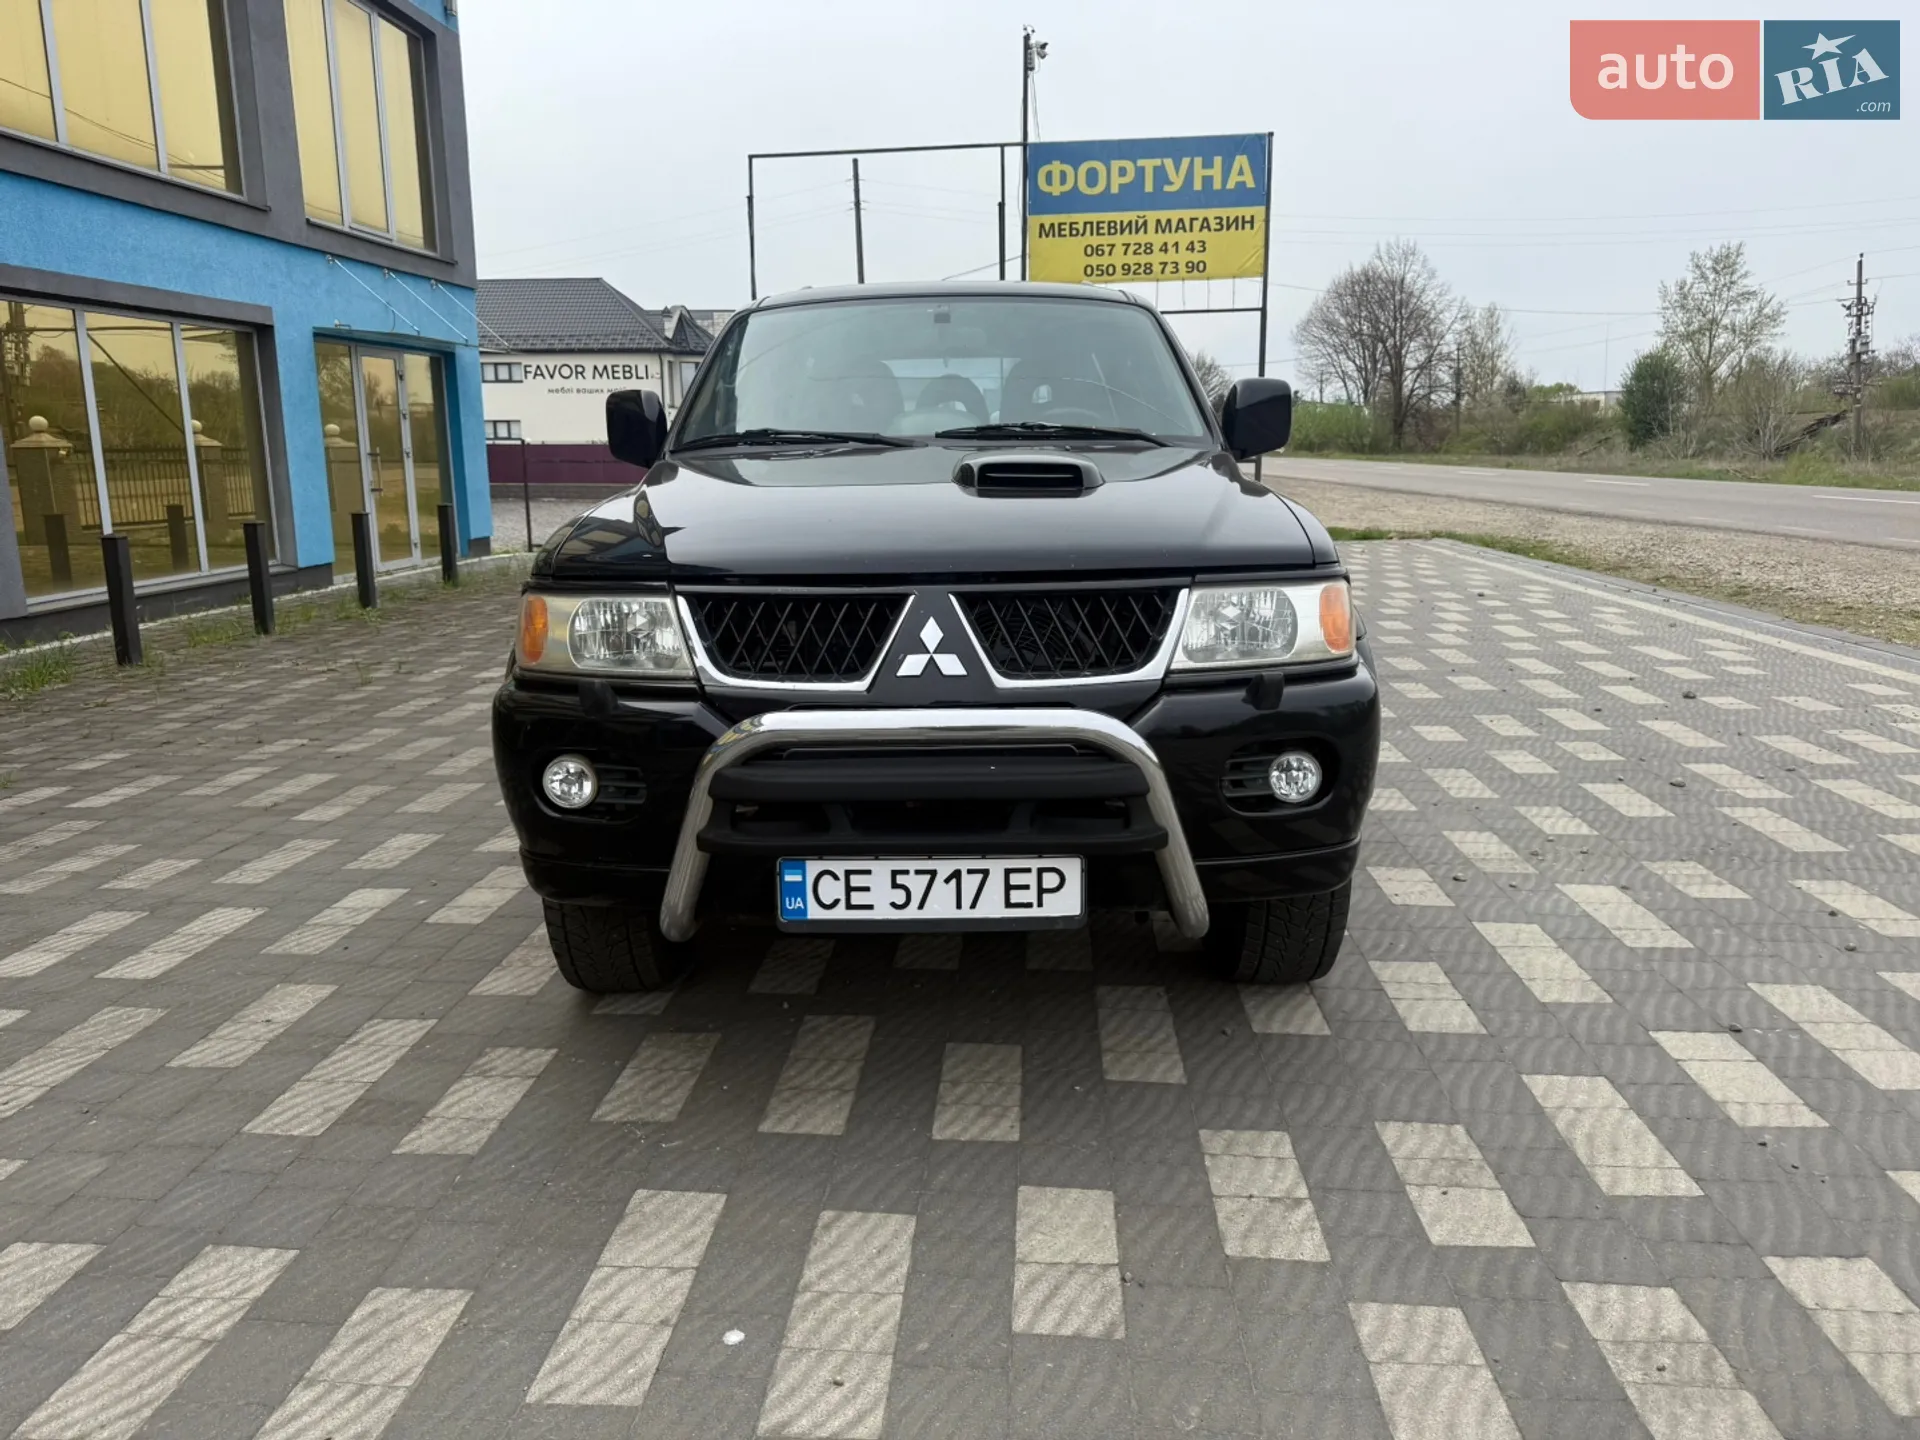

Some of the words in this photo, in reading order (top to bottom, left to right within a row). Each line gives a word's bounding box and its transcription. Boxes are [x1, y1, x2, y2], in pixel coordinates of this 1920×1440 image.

[1037, 154, 1256, 196] ФОРТУНА
[1038, 215, 1149, 239] МЕБЛЕВИЙ
[1154, 215, 1255, 234] МАГАЗИН
[1083, 243, 1117, 257] 067
[1122, 242, 1154, 256] 728
[1158, 241, 1181, 255] 41
[1185, 240, 1207, 253] 43
[1083, 263, 1117, 278] 050
[1121, 262, 1154, 276] 928
[1159, 261, 1180, 275] 73
[1185, 260, 1207, 274] 90
[523, 364, 586, 380] FAVOR
[592, 364, 649, 380] MEBLI
[812, 869, 874, 911] CE
[889, 868, 991, 911] 5717
[1003, 866, 1067, 909] EP
[785, 897, 805, 910] UA
